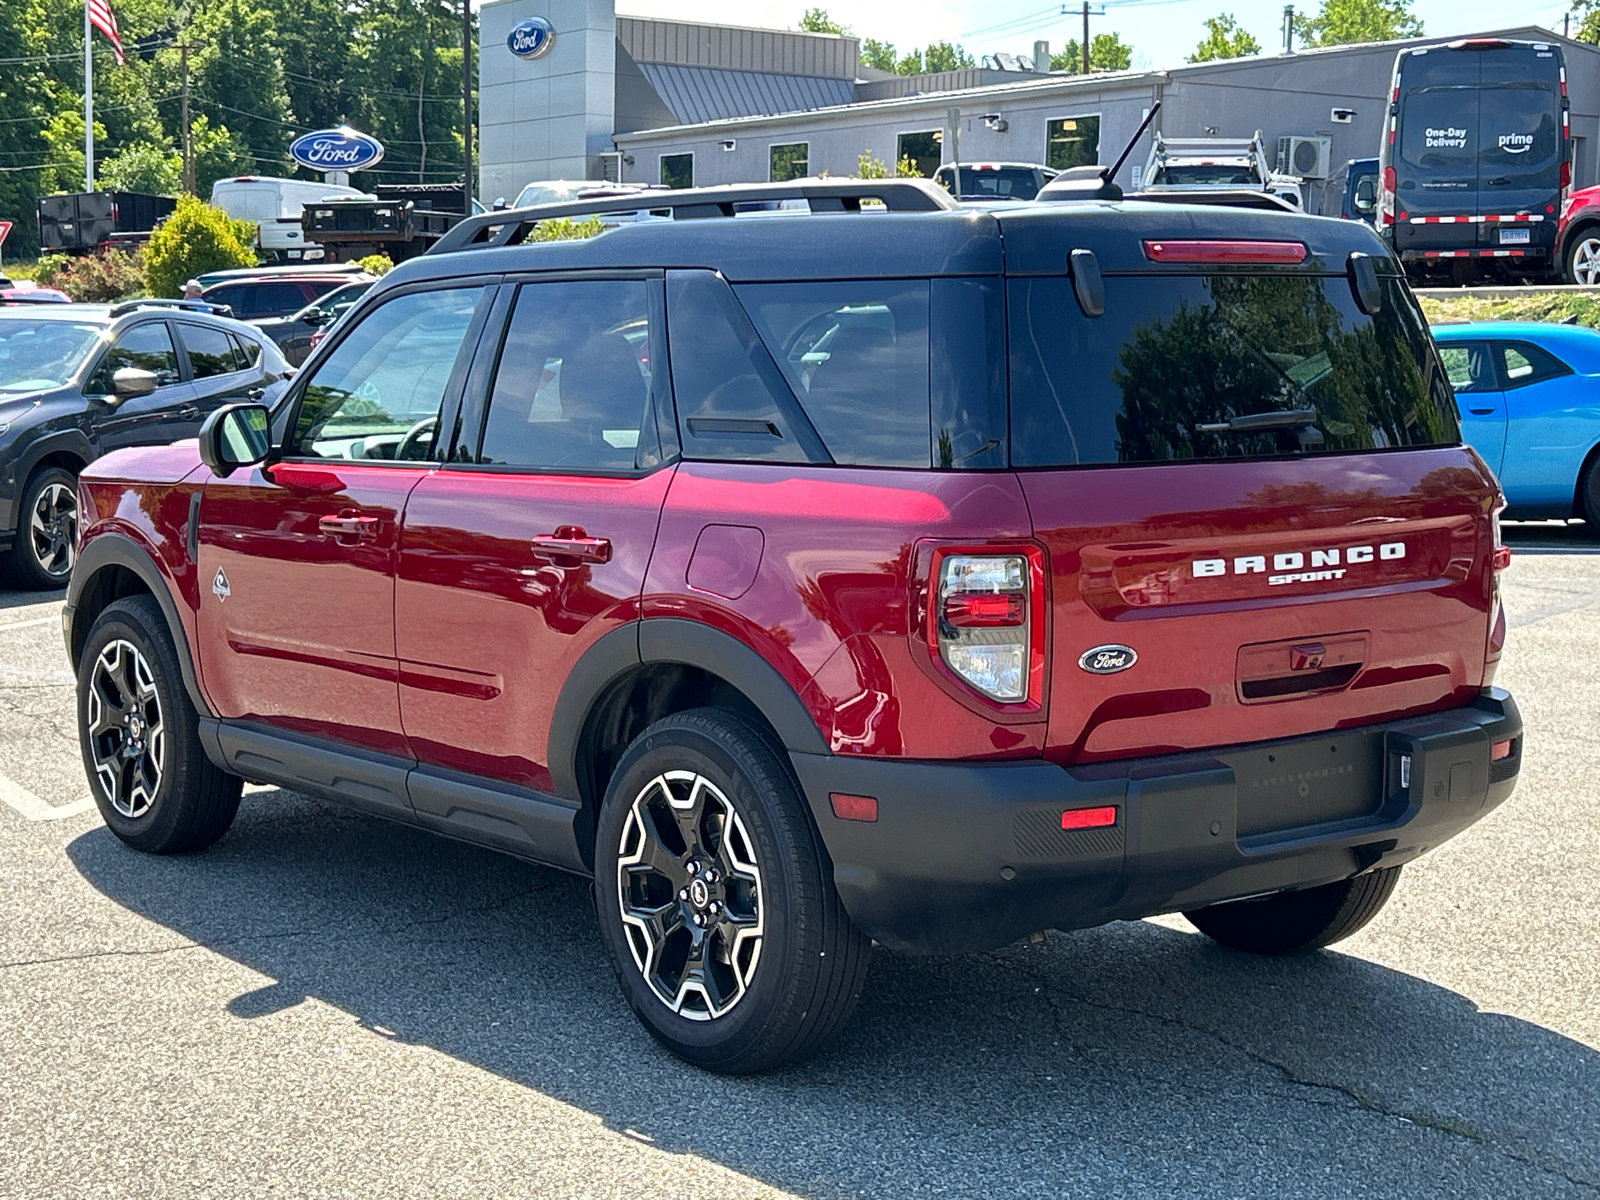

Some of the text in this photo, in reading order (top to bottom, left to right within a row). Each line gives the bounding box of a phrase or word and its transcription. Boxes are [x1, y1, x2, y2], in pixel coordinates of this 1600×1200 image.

[513, 27, 538, 50] Ford
[1425, 128, 1467, 138] One-Day
[1498, 133, 1533, 147] prime
[308, 138, 360, 162] Ford
[1426, 138, 1467, 148] Delivery
[1192, 542, 1406, 578] BRONCO
[1268, 569, 1347, 586] SPORT
[1093, 651, 1126, 669] Ford
